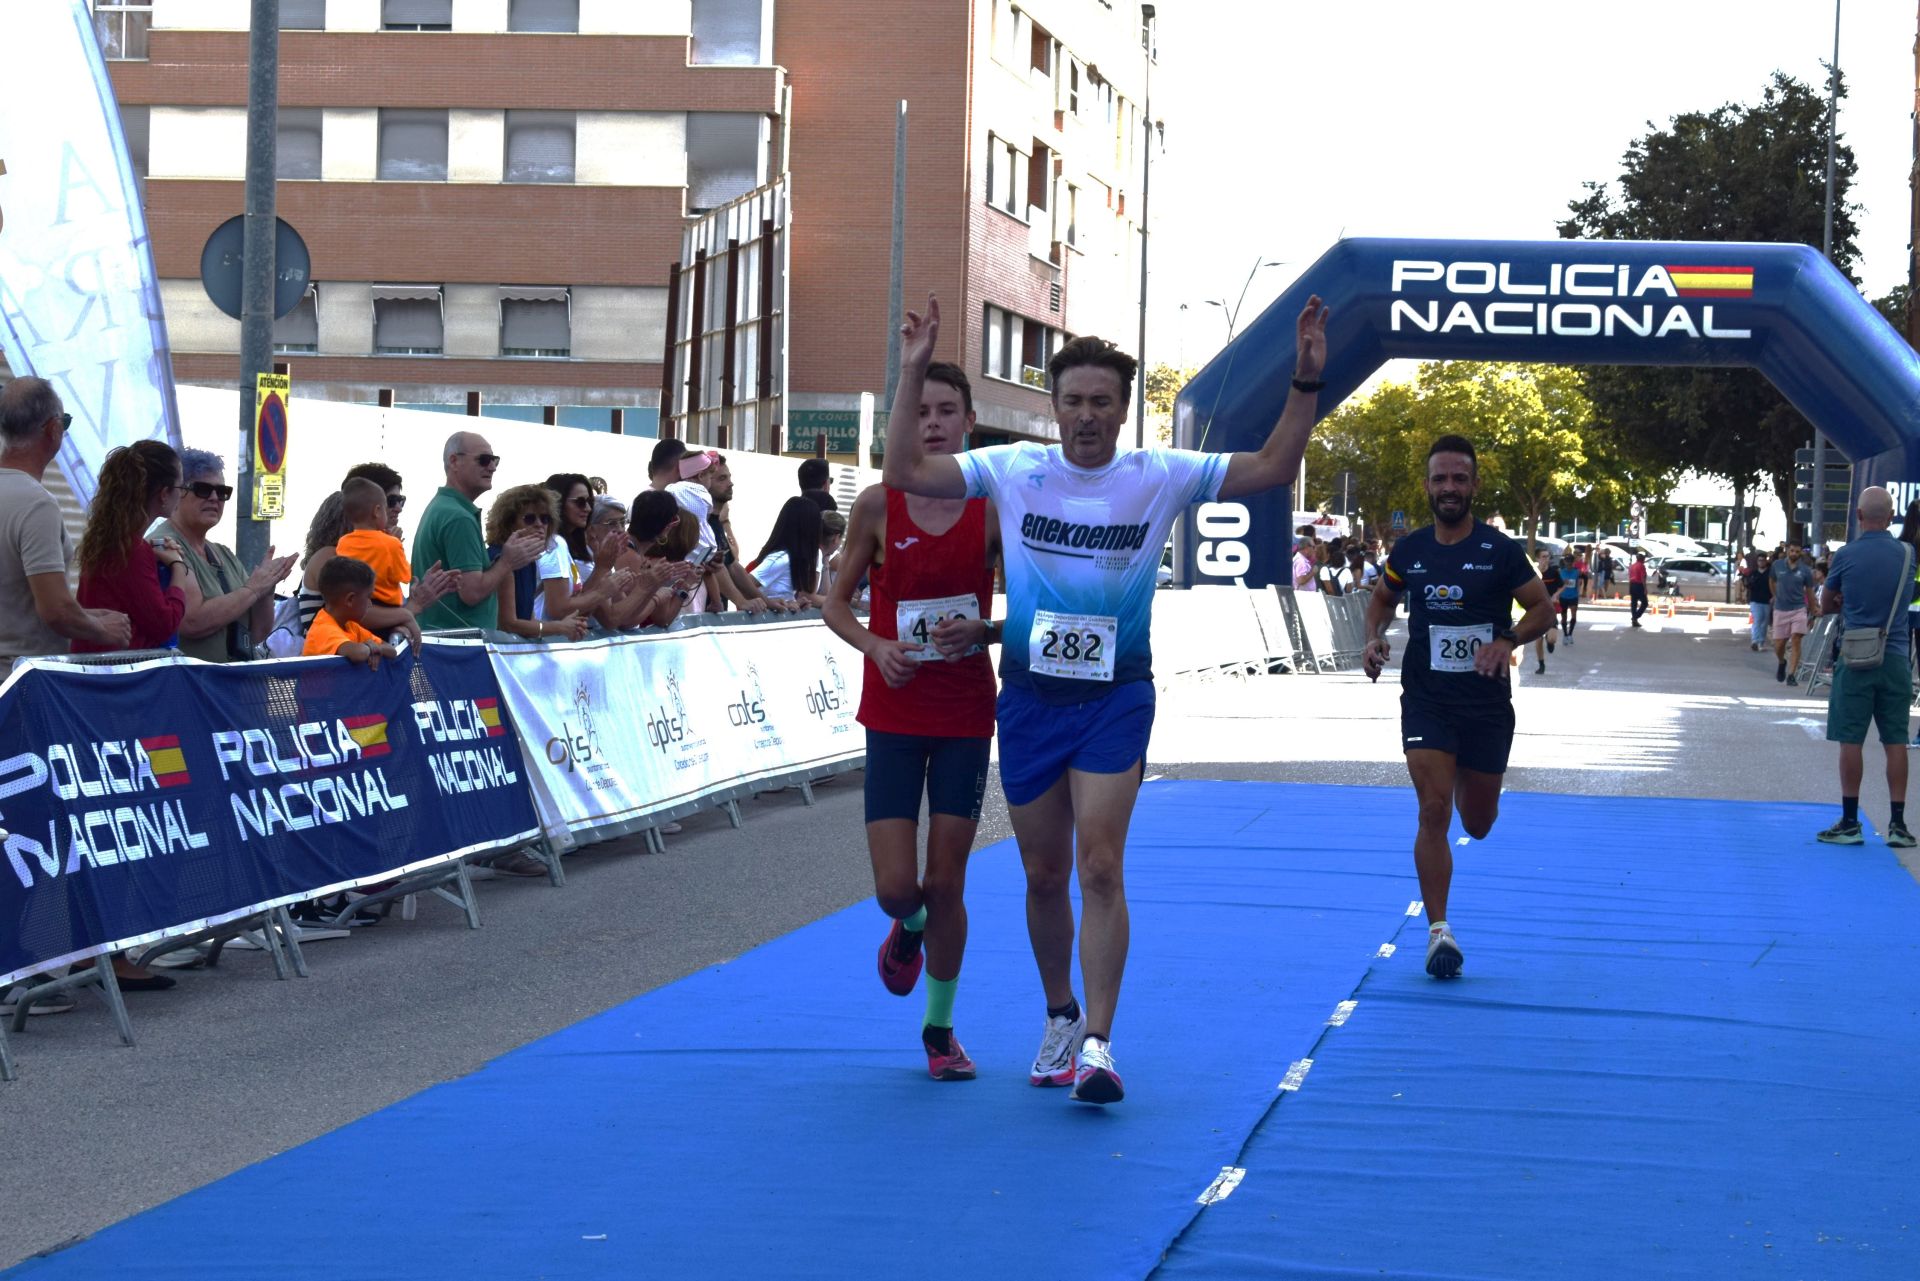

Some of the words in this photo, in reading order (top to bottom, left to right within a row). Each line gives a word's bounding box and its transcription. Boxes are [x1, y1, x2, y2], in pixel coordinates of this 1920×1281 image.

[1391, 299, 1751, 338] NACIONAL
[1424, 584, 1464, 601] 200
[1042, 630, 1102, 662] 282
[427, 746, 518, 797] NACIONAL
[230, 767, 409, 842] NACIONAL
[3, 799, 210, 889] NACIONAL
